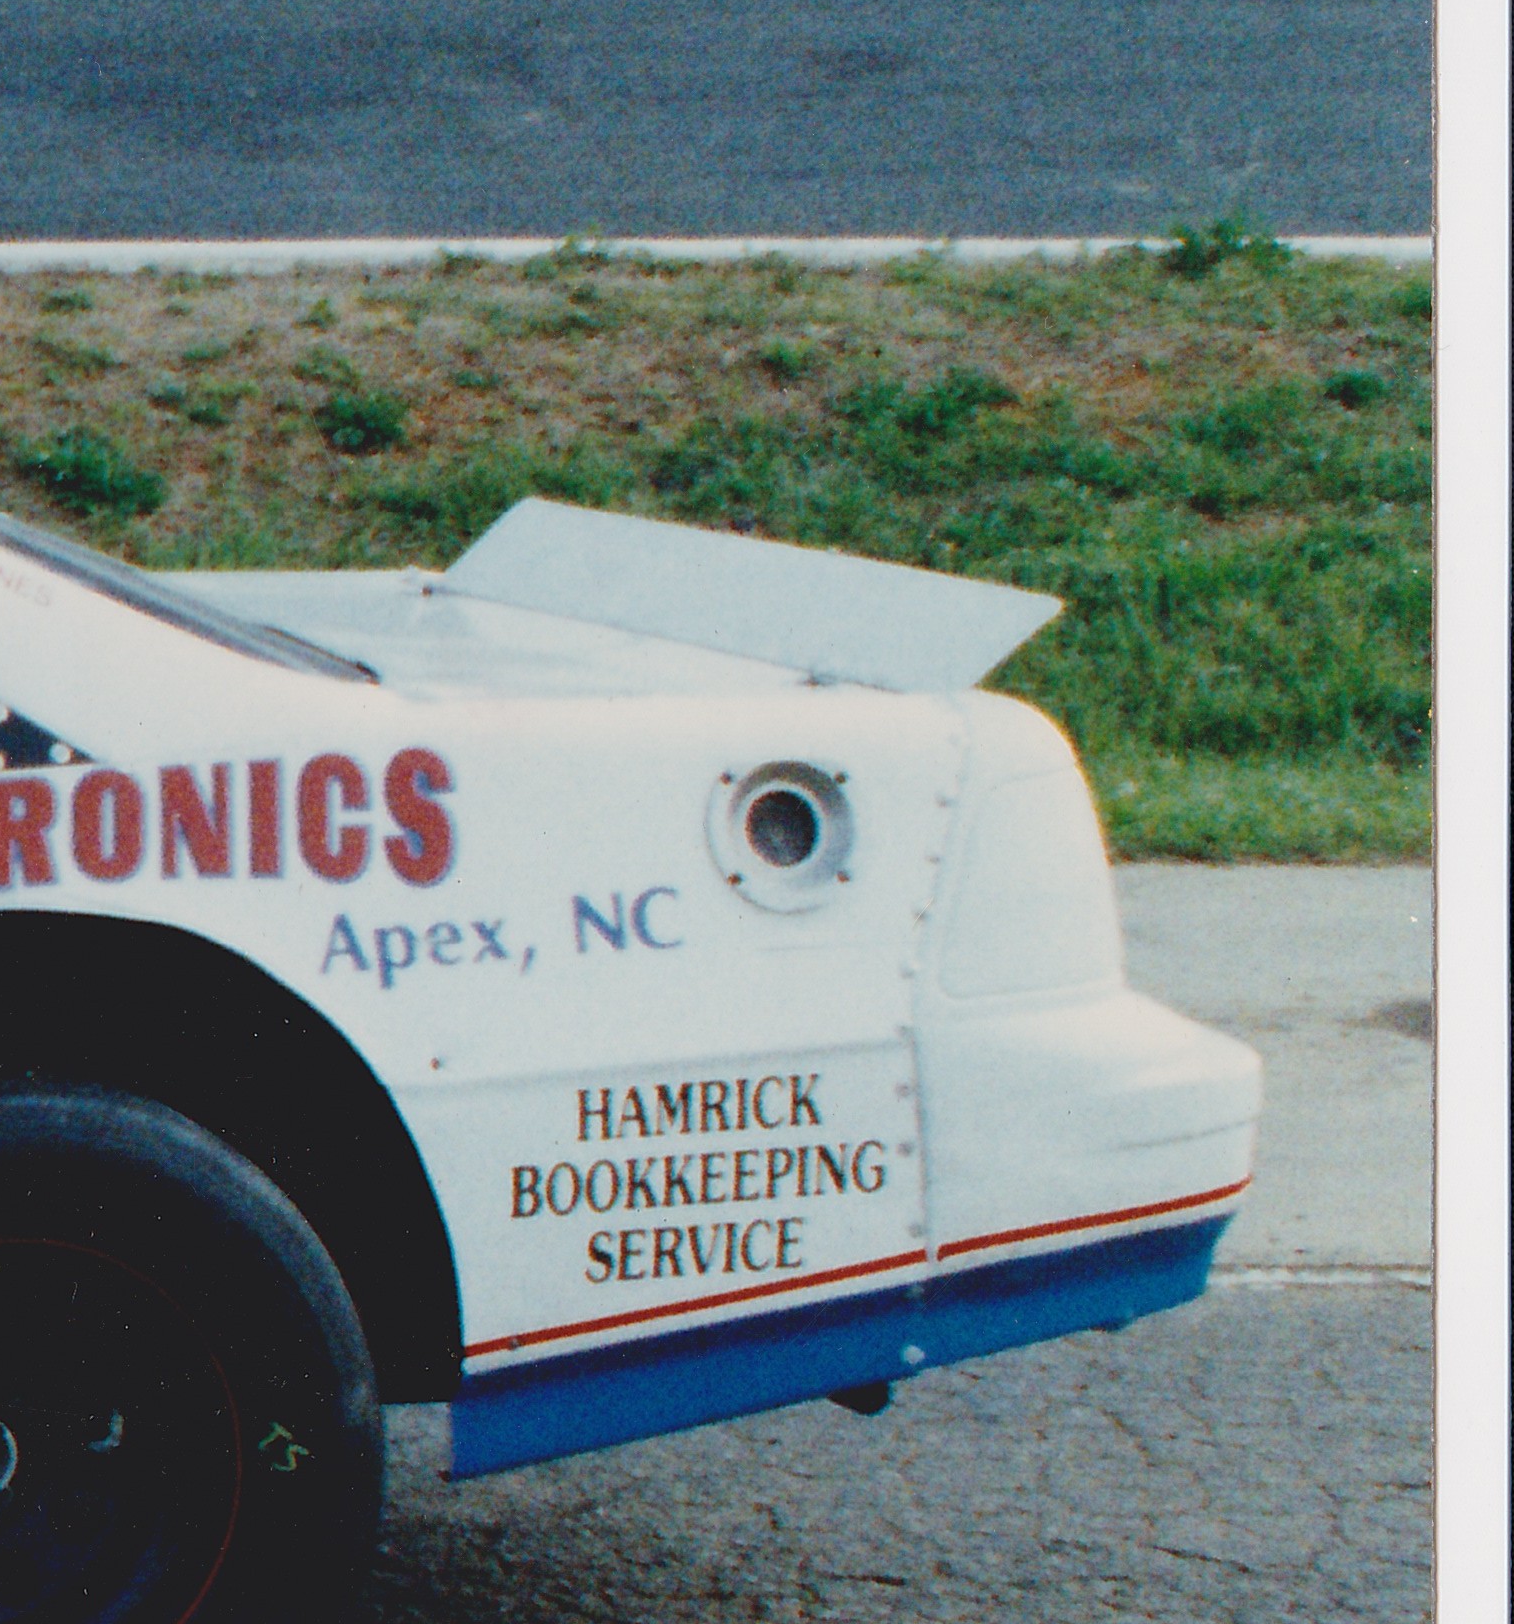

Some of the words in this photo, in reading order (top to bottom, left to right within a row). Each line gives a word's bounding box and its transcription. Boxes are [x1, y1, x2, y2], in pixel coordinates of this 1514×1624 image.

[320, 912, 536, 990] Apex,
[572, 886, 684, 953] NC
[576, 1073, 824, 1142] HAMRICK
[510, 1139, 888, 1220] BOOKKEEPING
[584, 1217, 806, 1284] SERVICE
